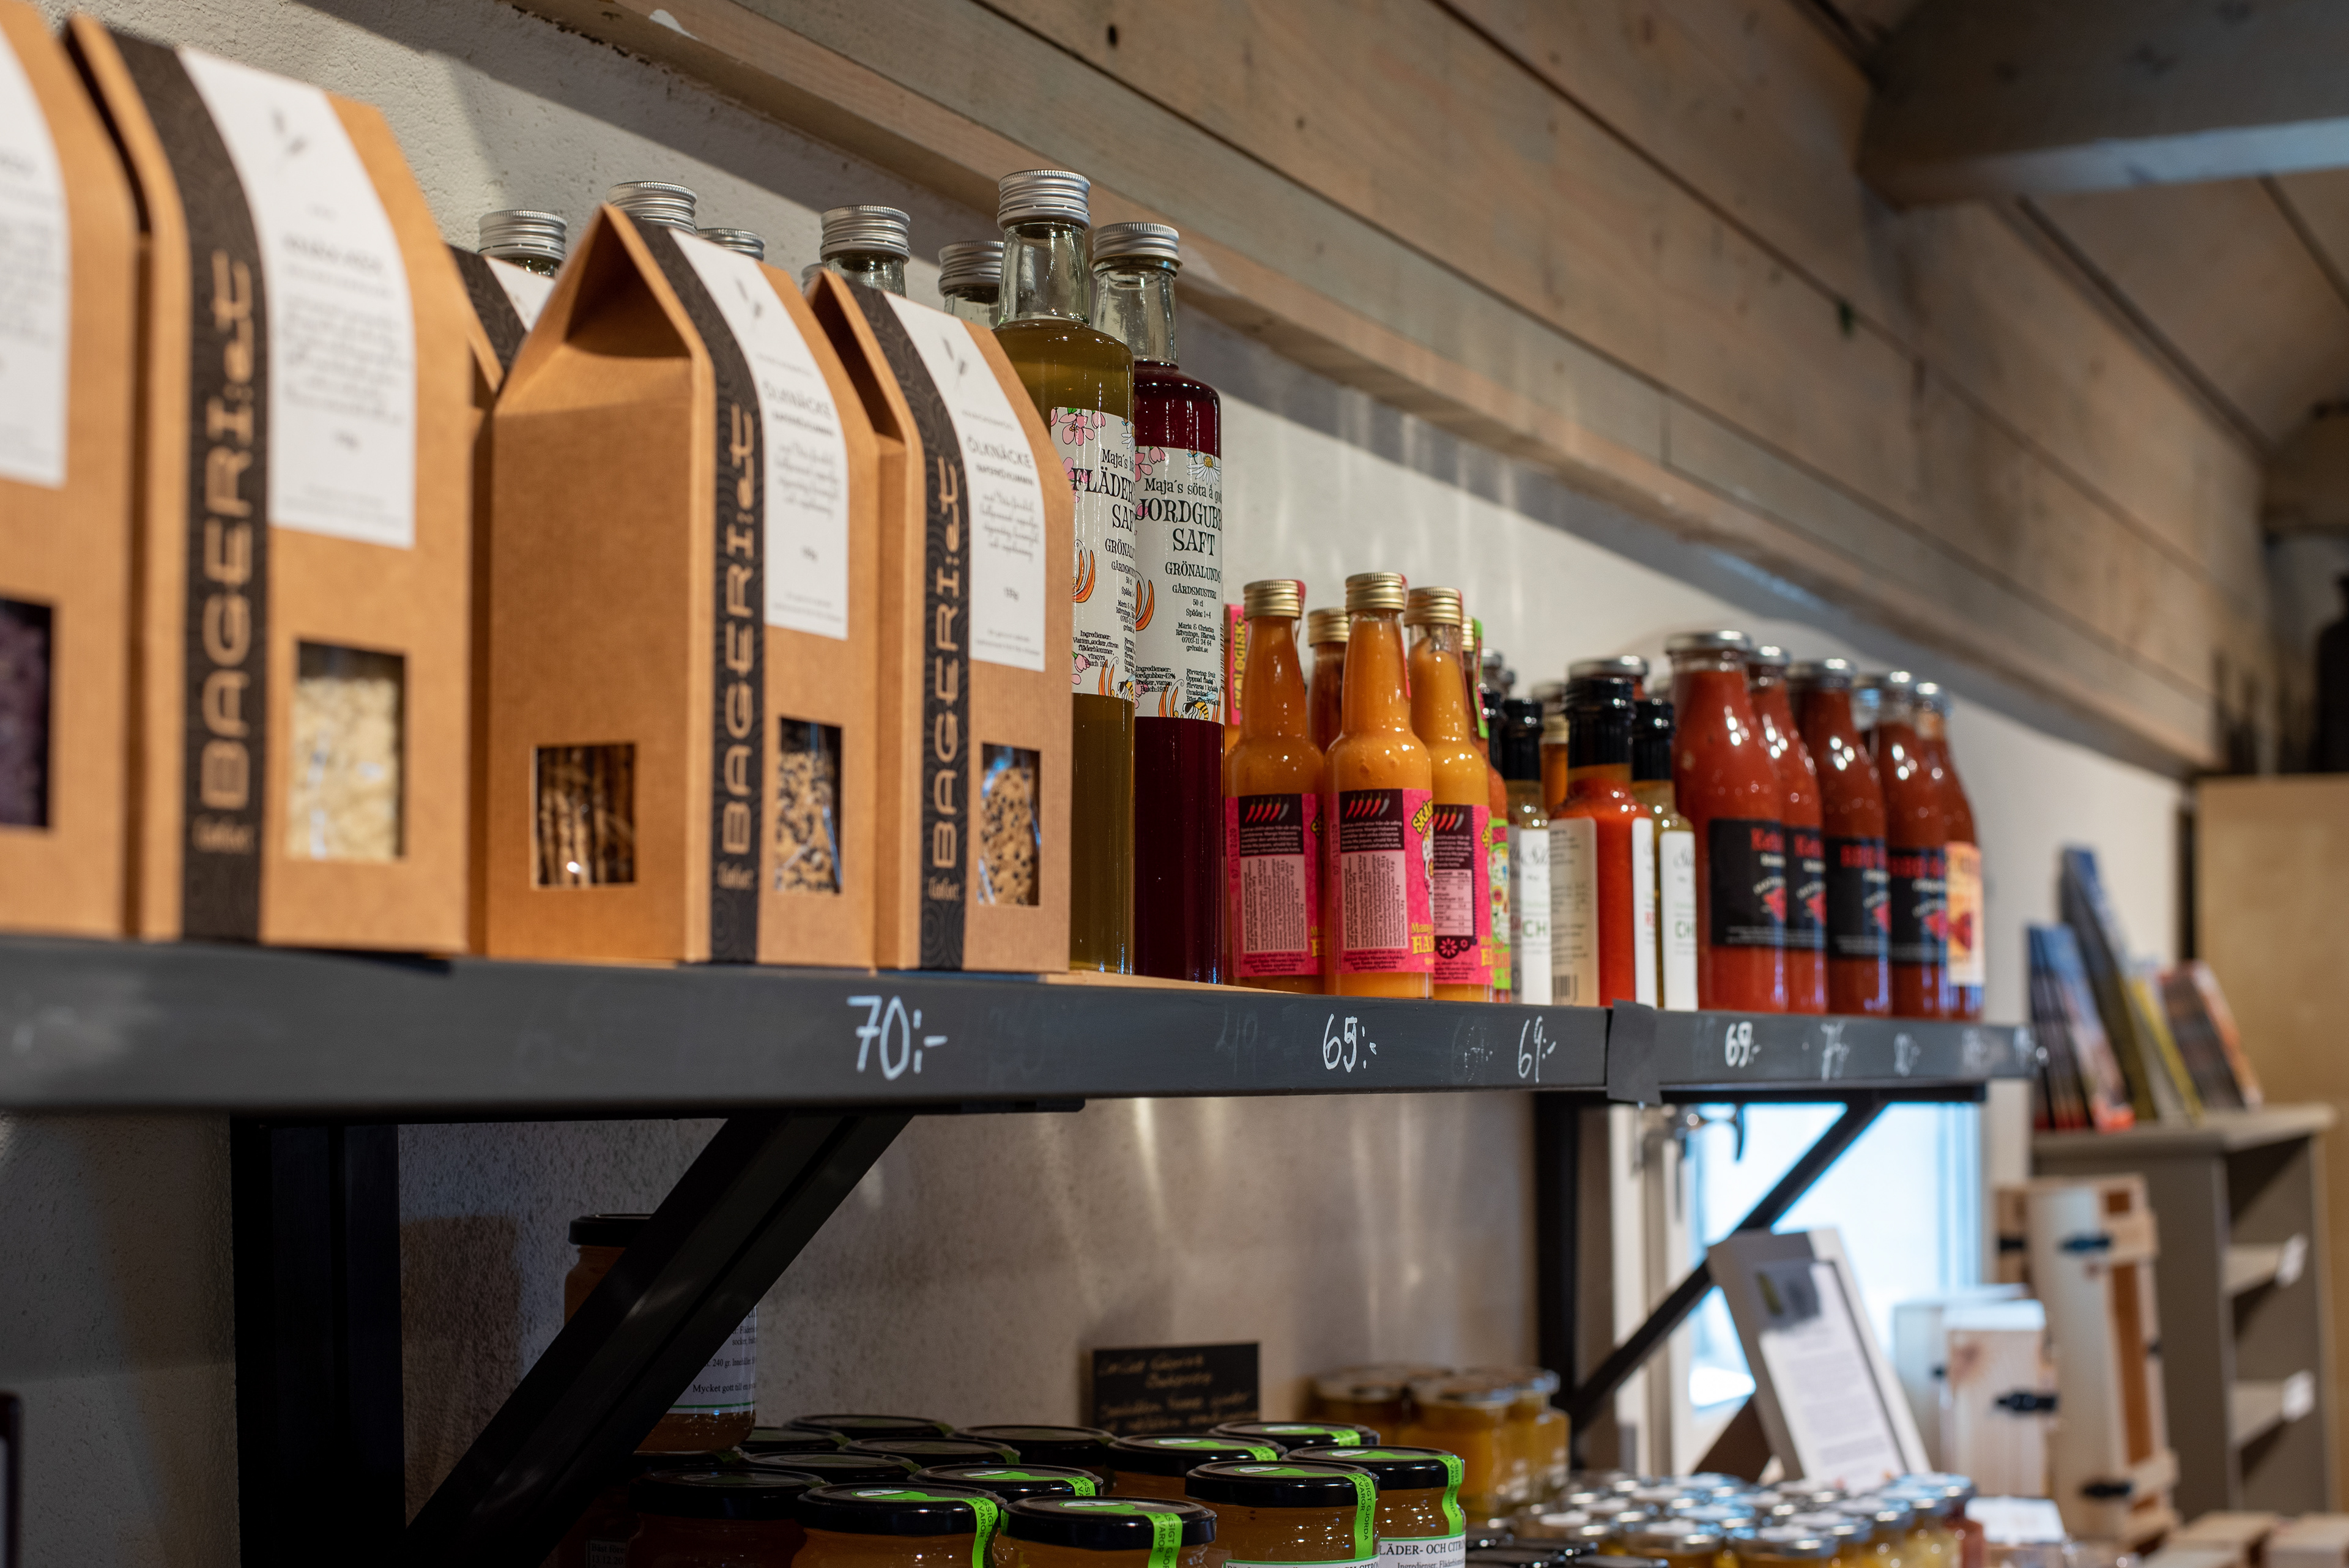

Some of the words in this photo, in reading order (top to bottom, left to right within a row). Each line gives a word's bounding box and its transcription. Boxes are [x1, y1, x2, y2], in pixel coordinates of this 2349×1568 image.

[1187, 483, 1207, 497] söta
[1173, 528, 1215, 556] SAFT
[1165, 560, 1221, 583] GRÖNALUNDS
[1172, 583, 1217, 600] GÅRDSMUSTERI
[1186, 608, 1203, 617] Spädes
[847, 995, 948, 1081] 70:-
[1323, 1013, 1378, 1072] 65:-
[692, 1384, 720, 1394] Mycket
[722, 1384, 733, 1394] gott
[592, 1544, 607, 1552] Bäst
[609, 1545, 625, 1553] före
[1380, 1544, 1423, 1555] LÄDER-
[1427, 1543, 1445, 1554] OCH
